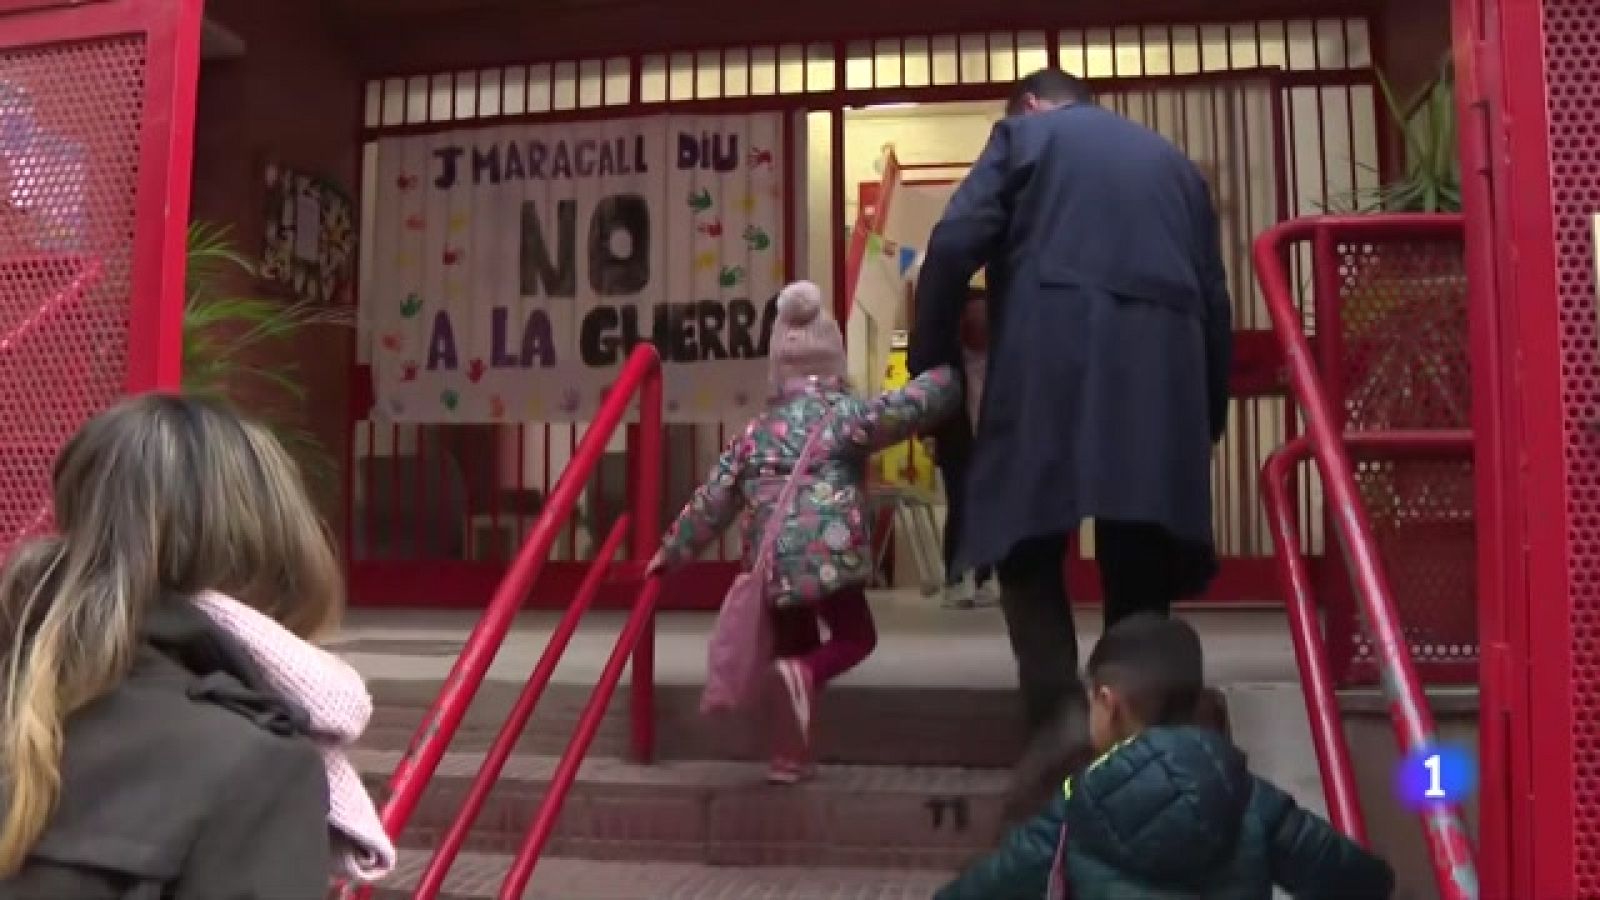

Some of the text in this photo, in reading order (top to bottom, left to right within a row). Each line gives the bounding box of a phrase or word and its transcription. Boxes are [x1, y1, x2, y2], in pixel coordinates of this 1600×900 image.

[433, 146, 464, 190] J
[519, 194, 651, 298] NO
[426, 309, 458, 371] A
[491, 306, 556, 369] LA
